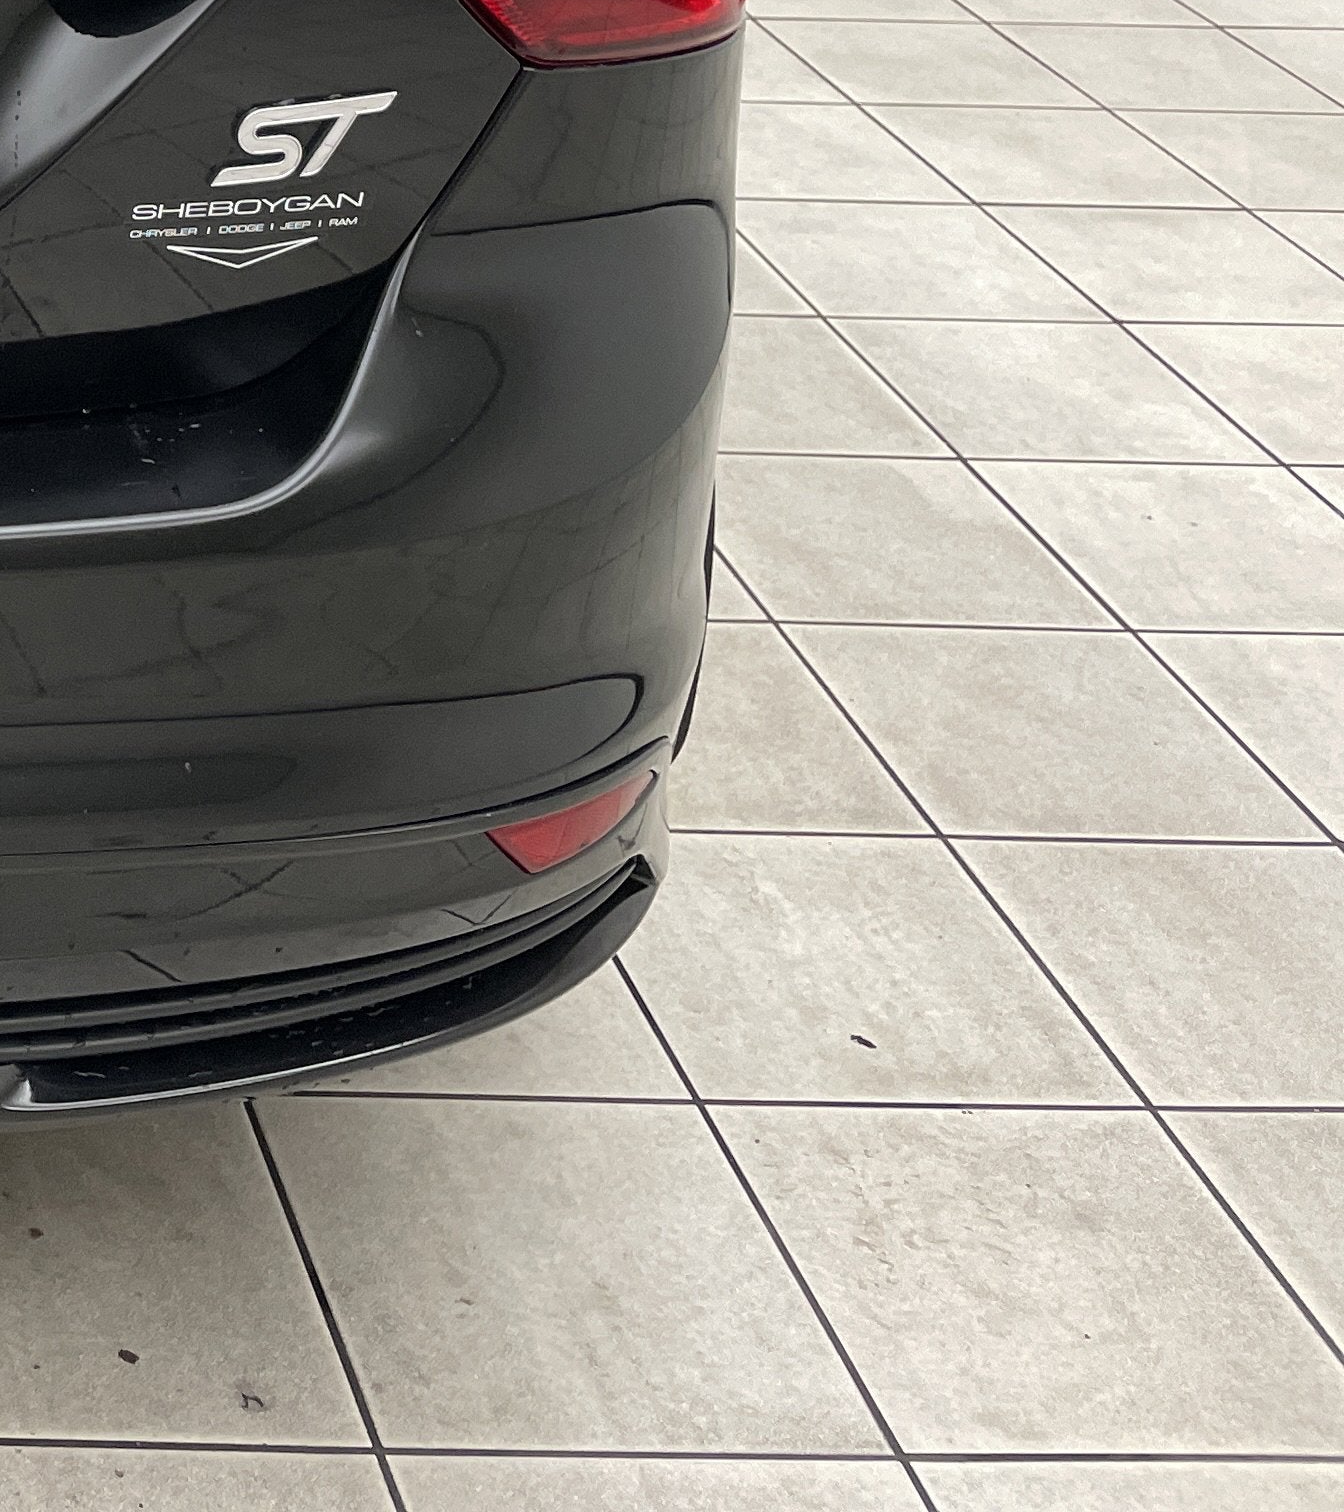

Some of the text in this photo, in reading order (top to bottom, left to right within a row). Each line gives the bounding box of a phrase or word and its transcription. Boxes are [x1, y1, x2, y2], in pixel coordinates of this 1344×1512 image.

[211, 91, 397, 187] ST
[131, 192, 365, 221] SHEBOYGAN
[130, 216, 359, 238] CHRYSLER DODGE JEEP RAM
